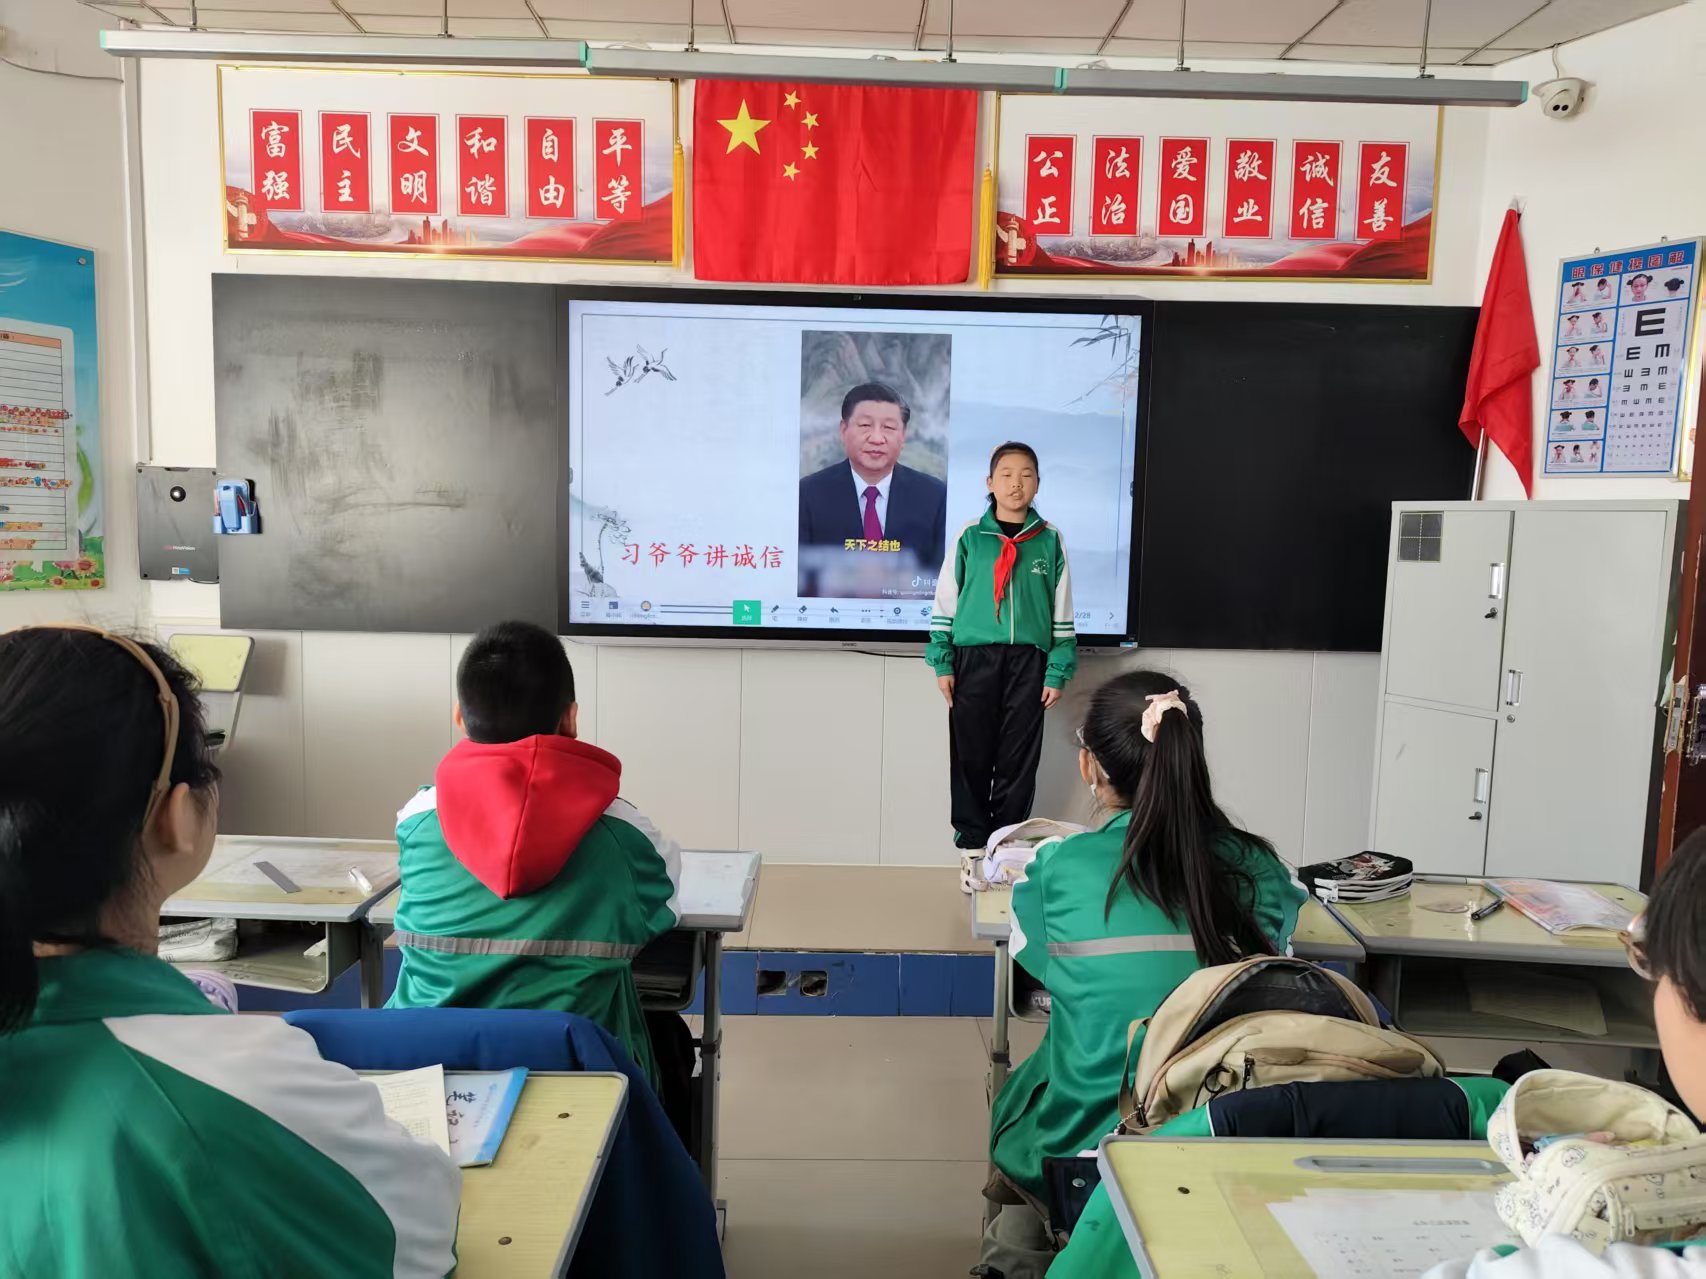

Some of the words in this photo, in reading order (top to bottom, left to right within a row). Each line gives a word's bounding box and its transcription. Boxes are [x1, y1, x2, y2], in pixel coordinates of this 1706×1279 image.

[260, 119, 291, 202] 富强
[331, 123, 362, 204] 民主
[397, 126, 430, 205] 文明
[463, 126, 498, 208] 和谐
[538, 128, 567, 209] 自由
[600, 128, 633, 214] 平等
[1032, 150, 1064, 226] 公正
[1100, 145, 1132, 227] 法治
[1167, 145, 1199, 226] 爱国
[1232, 151, 1268, 225] 敬业
[1299, 153, 1335, 231] 诚信
[1362, 151, 1398, 233] 友善
[620, 541, 785, 570] 习爷爷讲诚信
[844, 538, 901, 552] 天下之结也
